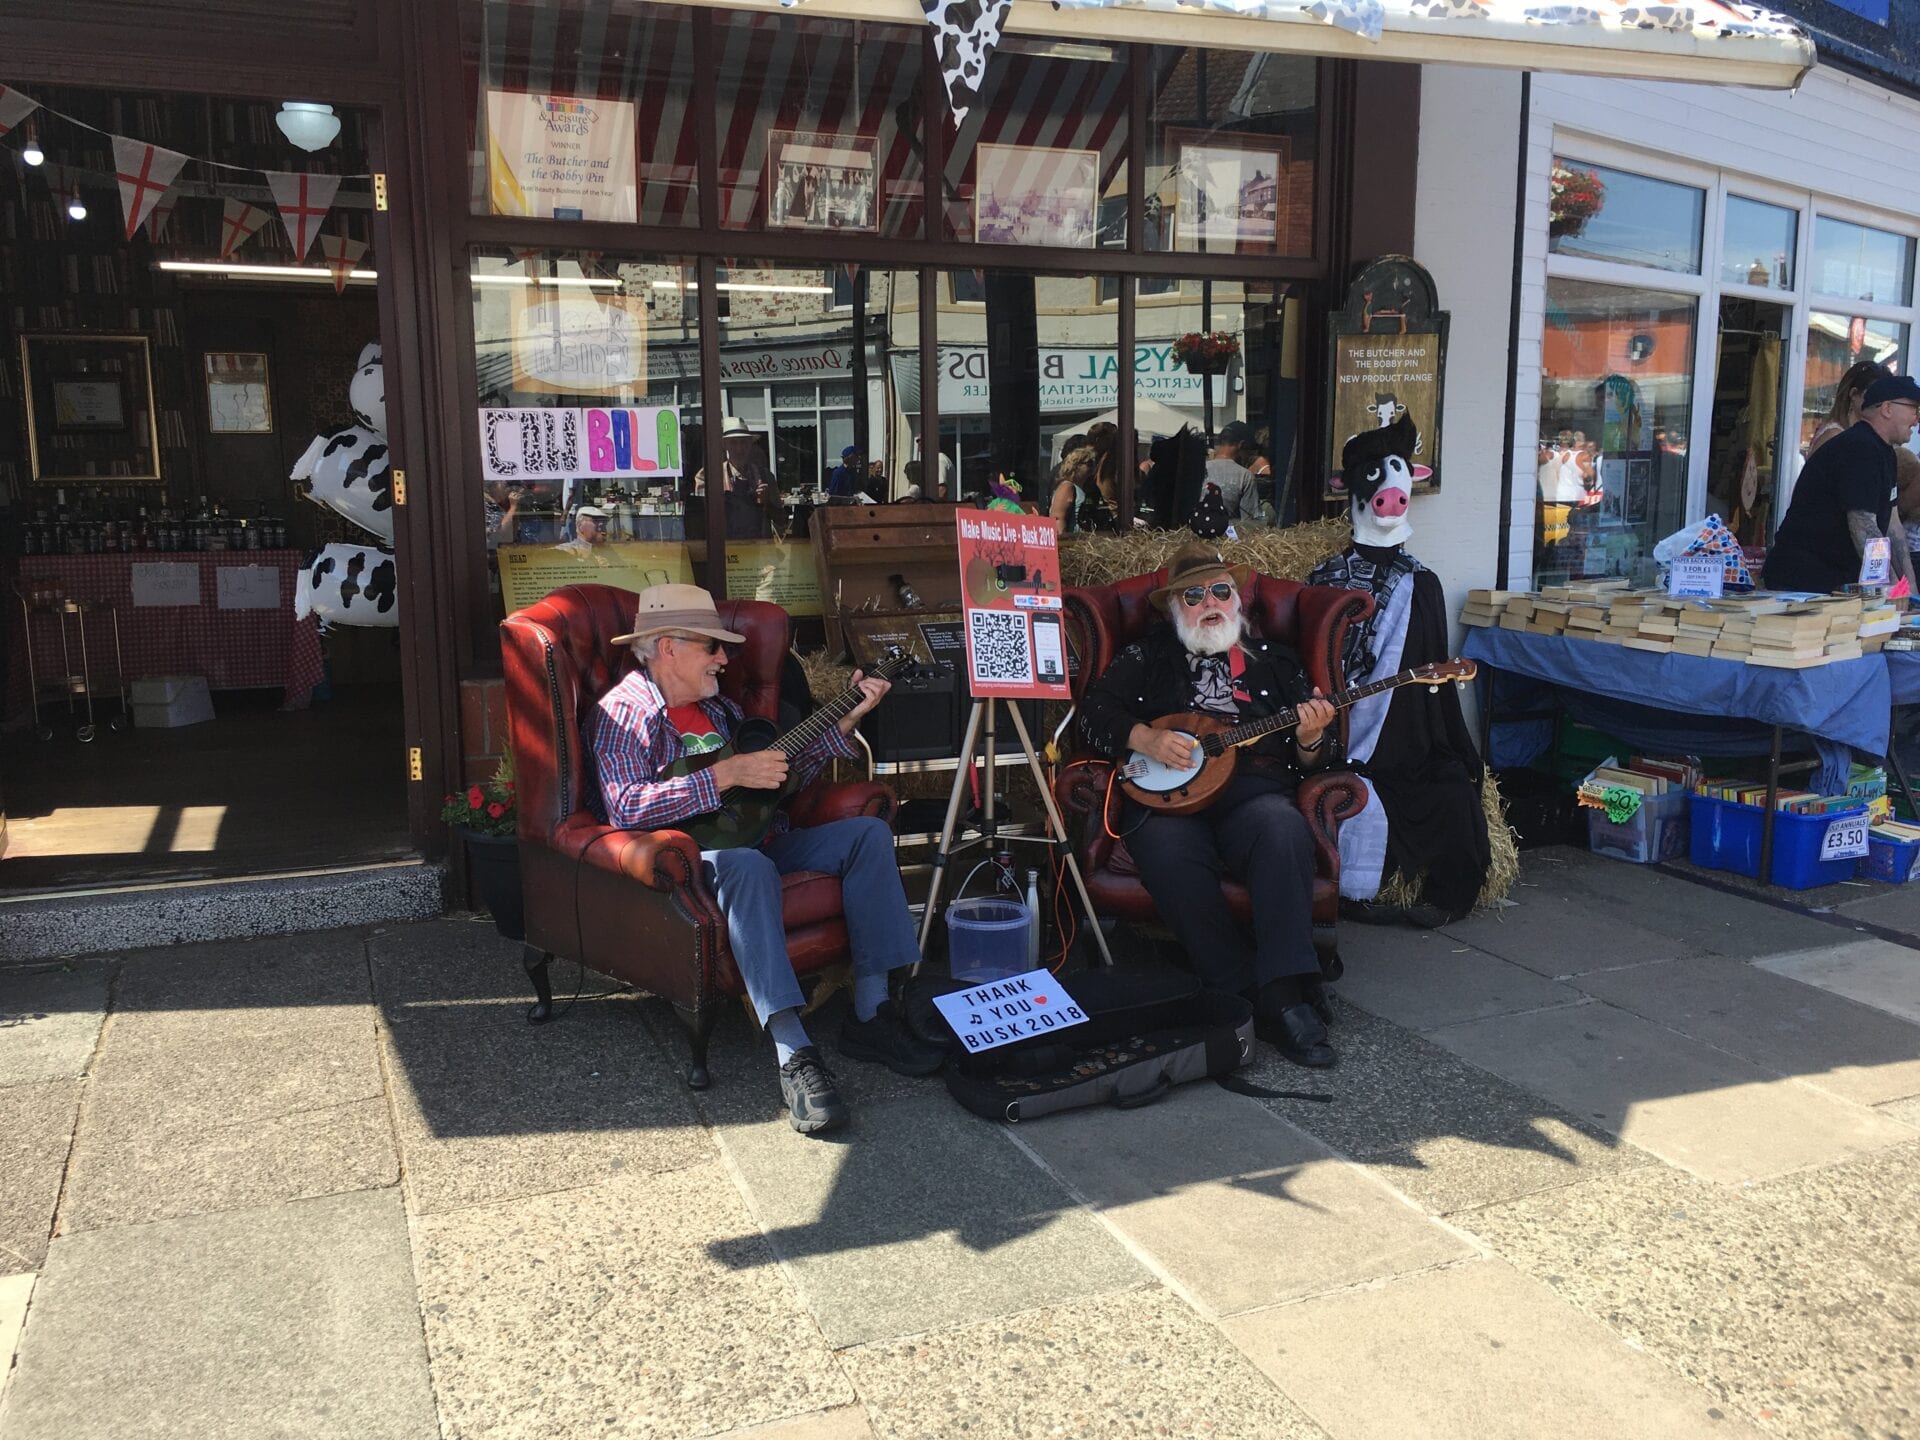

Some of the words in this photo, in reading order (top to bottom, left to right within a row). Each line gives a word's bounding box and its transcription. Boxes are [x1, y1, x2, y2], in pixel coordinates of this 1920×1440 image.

[551, 111, 587, 124] Leisure
[544, 118, 589, 136] Awards
[551, 141, 581, 150] WINNER
[524, 152, 544, 164] The
[546, 154, 589, 167] Butcher
[590, 157, 611, 169] and
[531, 168, 548, 179] the
[550, 169, 584, 185] Bobby
[586, 172, 604, 183] Pin
[1348, 349, 1365, 358] THE
[1366, 348, 1406, 358] BUTCHER
[1407, 348, 1426, 357] AND
[1355, 360, 1372, 369] THE
[1373, 359, 1403, 368] BOBBY
[1404, 359, 1419, 368] PIN
[1340, 375, 1360, 383] NEW
[1362, 374, 1402, 383] PRODUCT
[1403, 373, 1433, 382] RANGE
[961, 518, 980, 539] Make
[981, 520, 1002, 542] Music
[1002, 522, 1017, 543] Live
[1021, 524, 1039, 545] Busk
[1039, 526, 1055, 547] 2018
[1840, 819, 1866, 830] ANNUALS
[1827, 829, 1863, 849] £3.50
[961, 979, 1033, 1007] THANK
[988, 999, 1032, 1020] YOU
[964, 1023, 1024, 1048] BUSK
[1025, 1006, 1082, 1031] 2018
